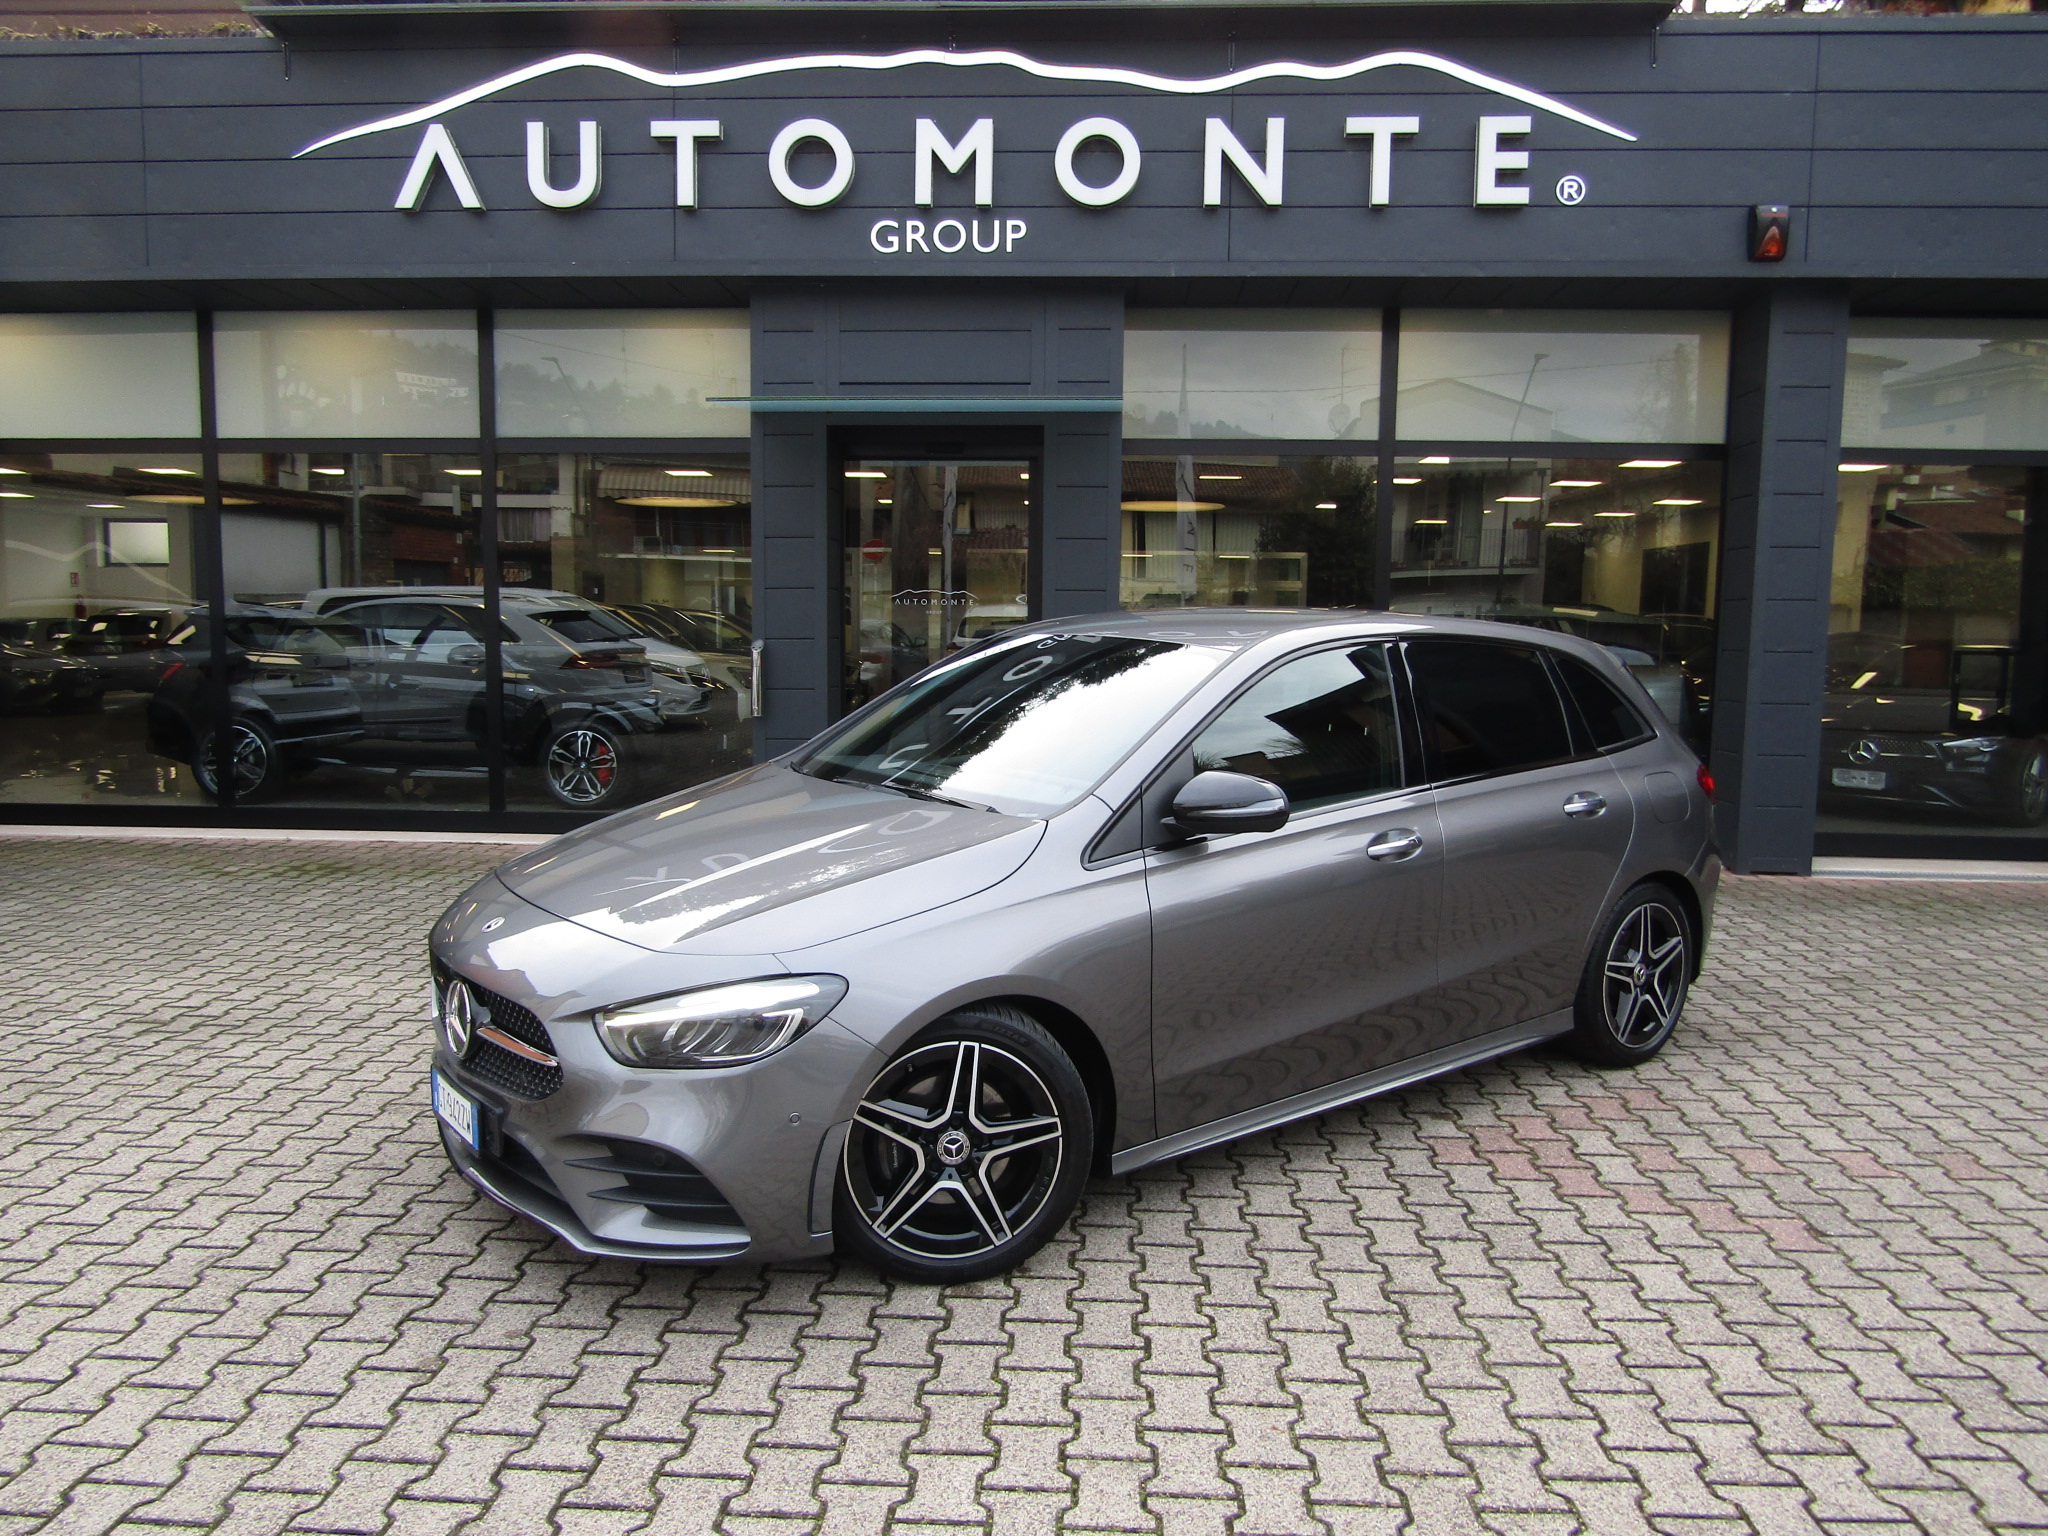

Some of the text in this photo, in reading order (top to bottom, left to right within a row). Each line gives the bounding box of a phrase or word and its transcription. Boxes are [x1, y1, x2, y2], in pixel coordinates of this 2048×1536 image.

[394, 115, 1533, 210] AUTOMONTE
[870, 219, 1028, 254] GROUP
[894, 598, 974, 606] AUTOMONTE
